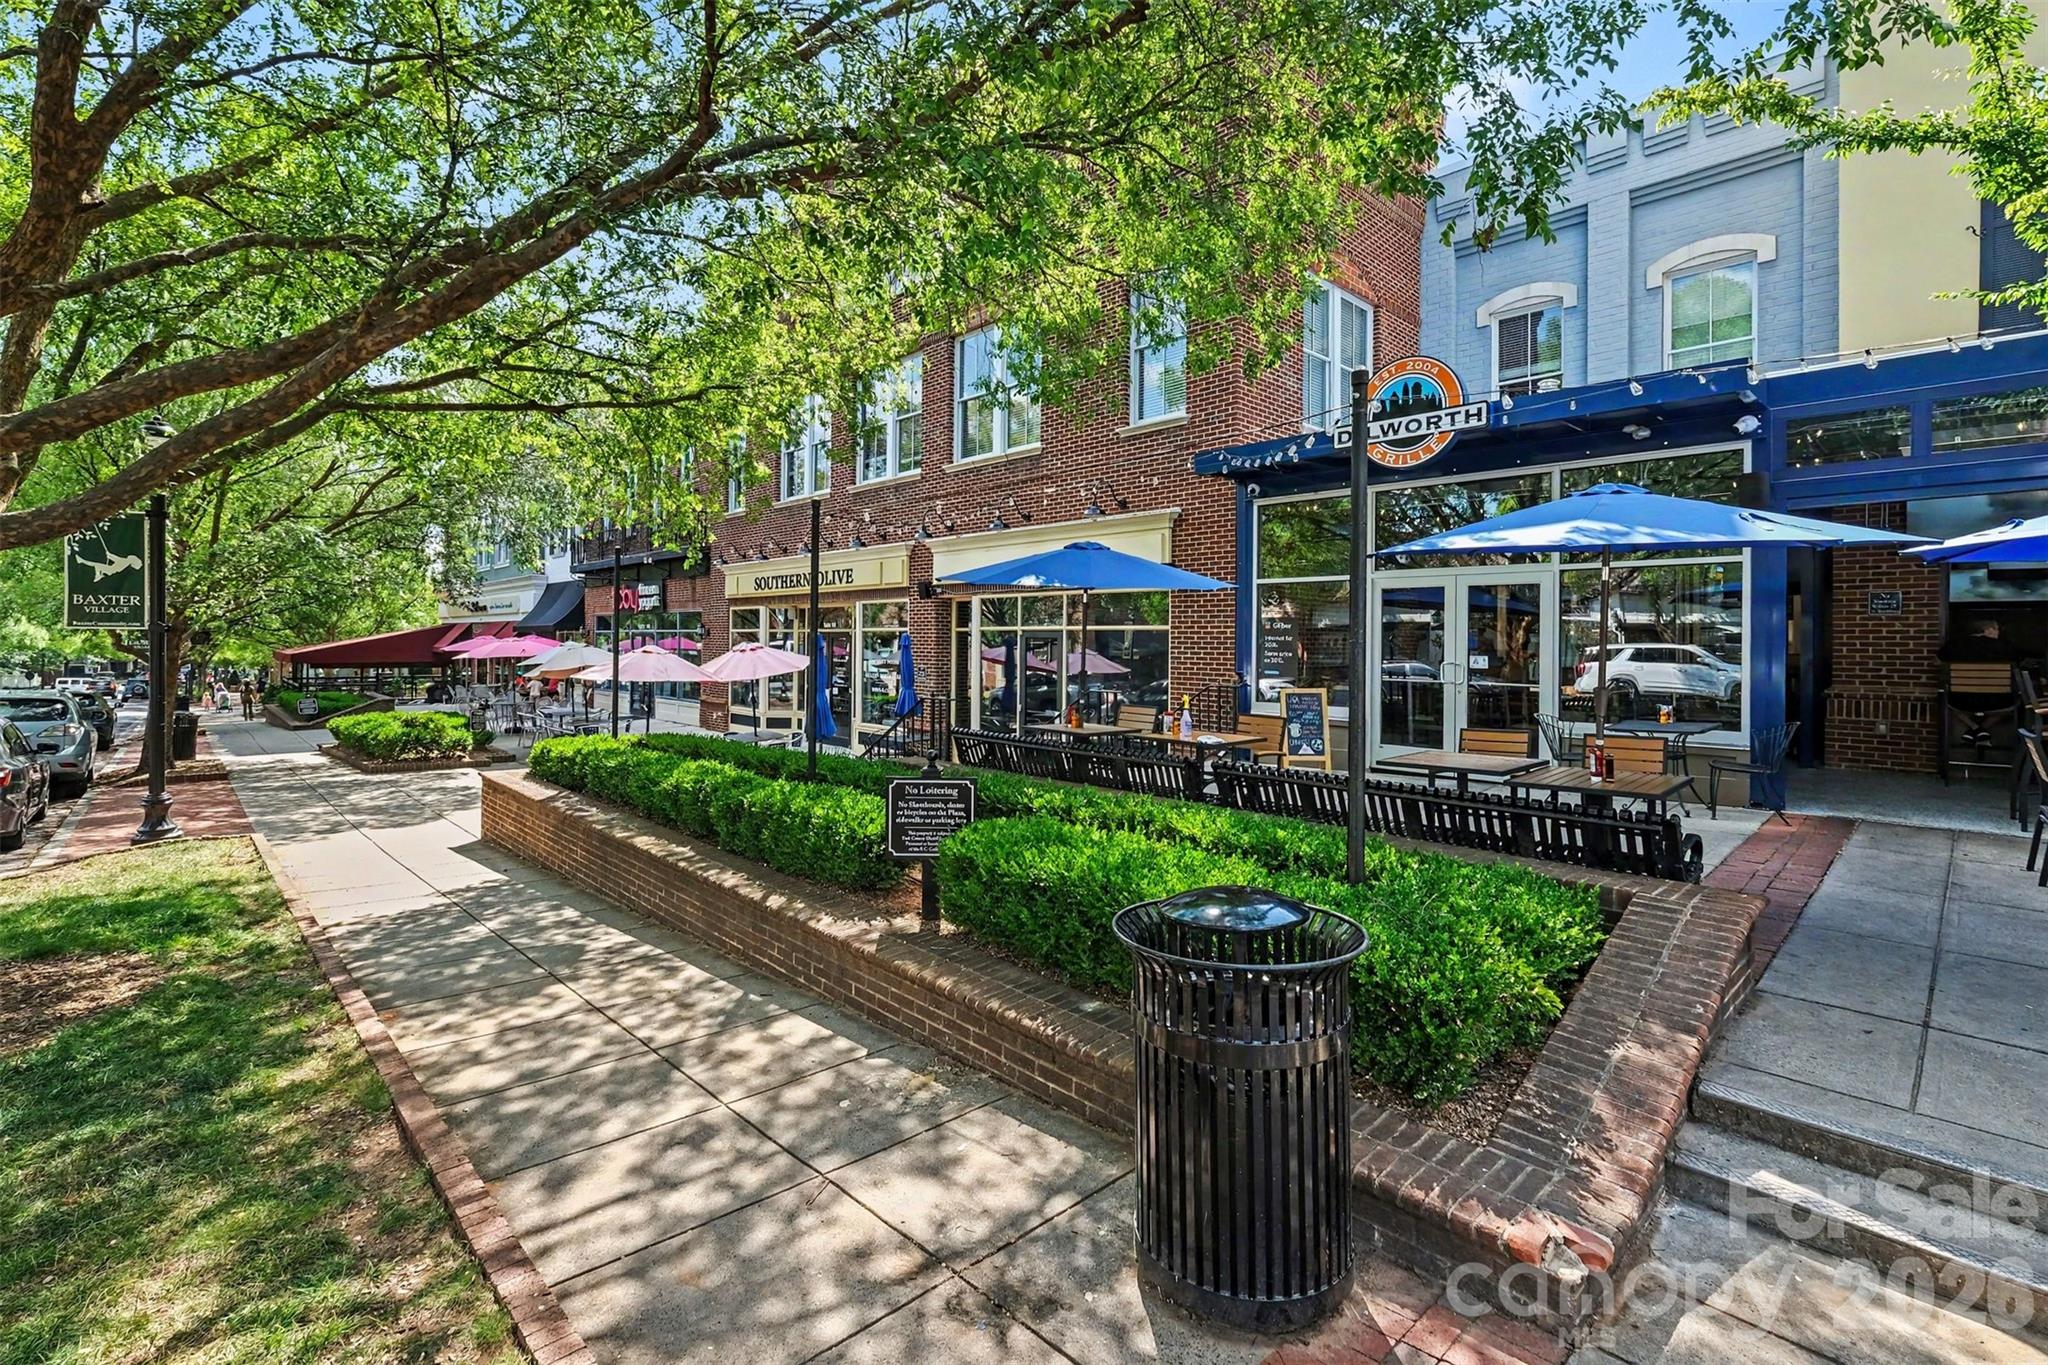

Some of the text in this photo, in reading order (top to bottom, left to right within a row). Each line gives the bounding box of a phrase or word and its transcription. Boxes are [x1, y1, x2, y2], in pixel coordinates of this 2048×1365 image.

[1373, 361, 1440, 386] EST. 2004
[1337, 406, 1483, 445] DLWORTH
[1372, 438, 1442, 465] GRILLE
[754, 568, 854, 592] SOUTHERN OLIVE
[72, 594, 141, 606] BAXTER
[83, 605, 130, 614] VILLAGE
[904, 785, 959, 797] No Loitering
[904, 809, 928, 818] bicycles
[932, 816, 955, 825] parking
